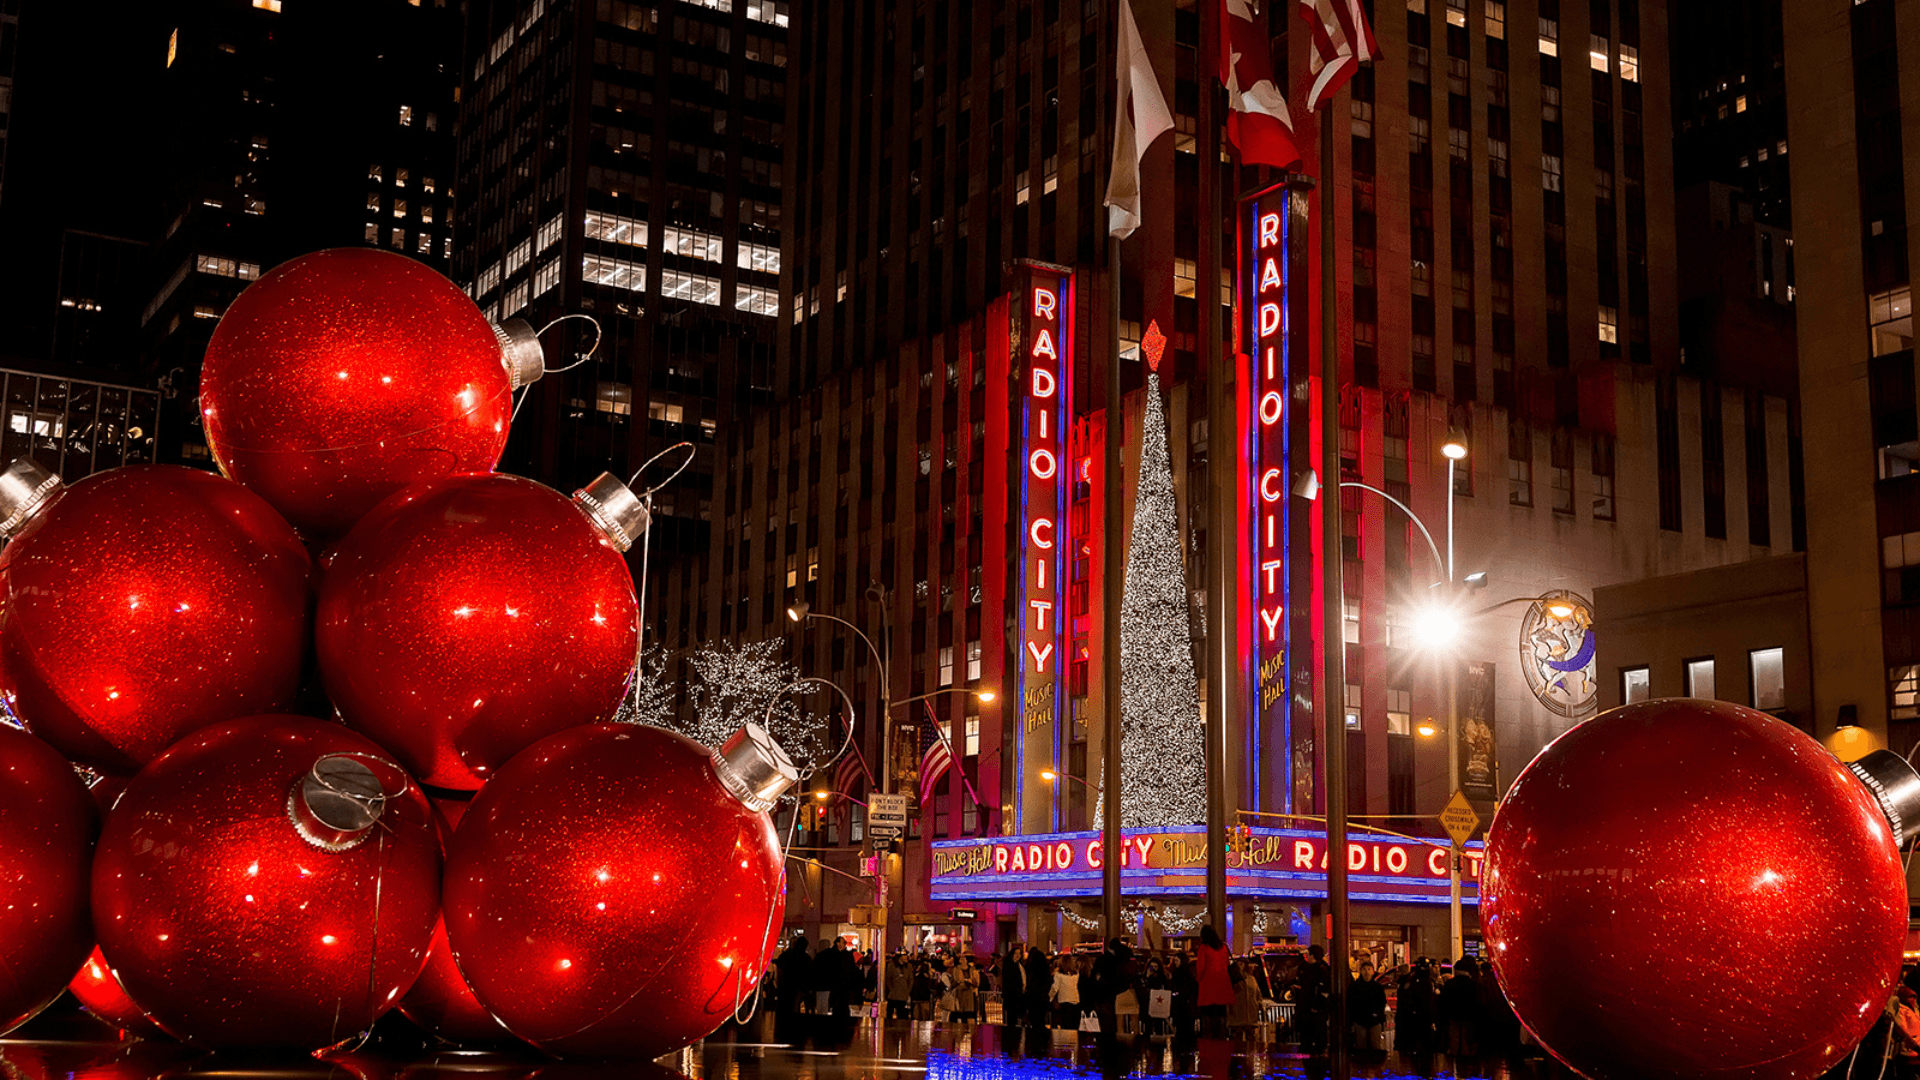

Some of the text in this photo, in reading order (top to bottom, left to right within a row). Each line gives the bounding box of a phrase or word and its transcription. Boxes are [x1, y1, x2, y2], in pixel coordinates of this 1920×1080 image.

[1259, 213, 1282, 641] RADIO CITY
[1028, 287, 1056, 673] RADIO CITY
[1264, 677, 1285, 711] HALL
[1028, 707, 1052, 733] HALL
[934, 851, 967, 876] Music
[964, 844, 993, 876] Hall
[995, 842, 1072, 873] RADIO
[1086, 836, 1153, 868] CTY
[1163, 838, 1208, 866] Mus
[1227, 836, 1282, 868] Hall
